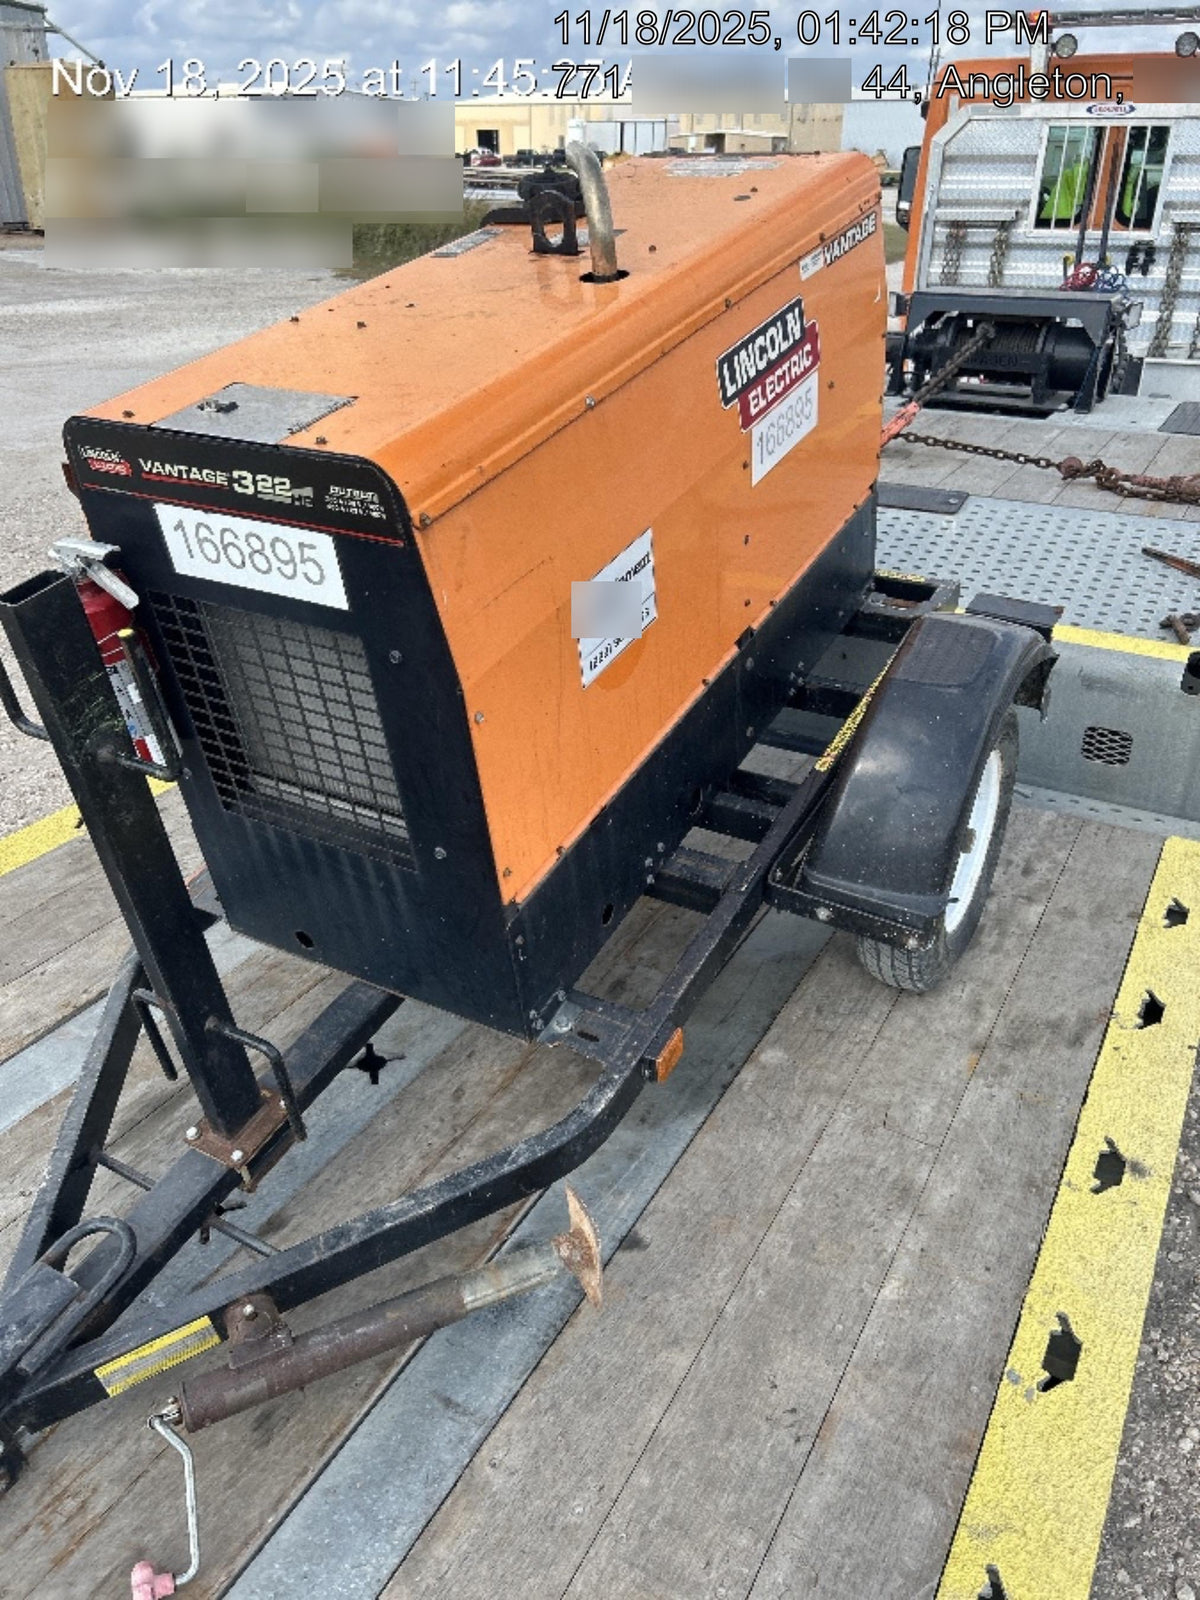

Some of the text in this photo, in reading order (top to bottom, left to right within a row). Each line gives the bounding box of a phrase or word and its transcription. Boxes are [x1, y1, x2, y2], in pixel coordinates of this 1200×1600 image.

[824, 212, 877, 266] VANTAGE
[722, 307, 802, 398] LINCOLN
[749, 344, 813, 417] ELECTRIC
[755, 387, 814, 465] 166895
[138, 456, 230, 487] VANTAGE
[231, 470, 293, 498] 322
[173, 519, 326, 586] 166895
